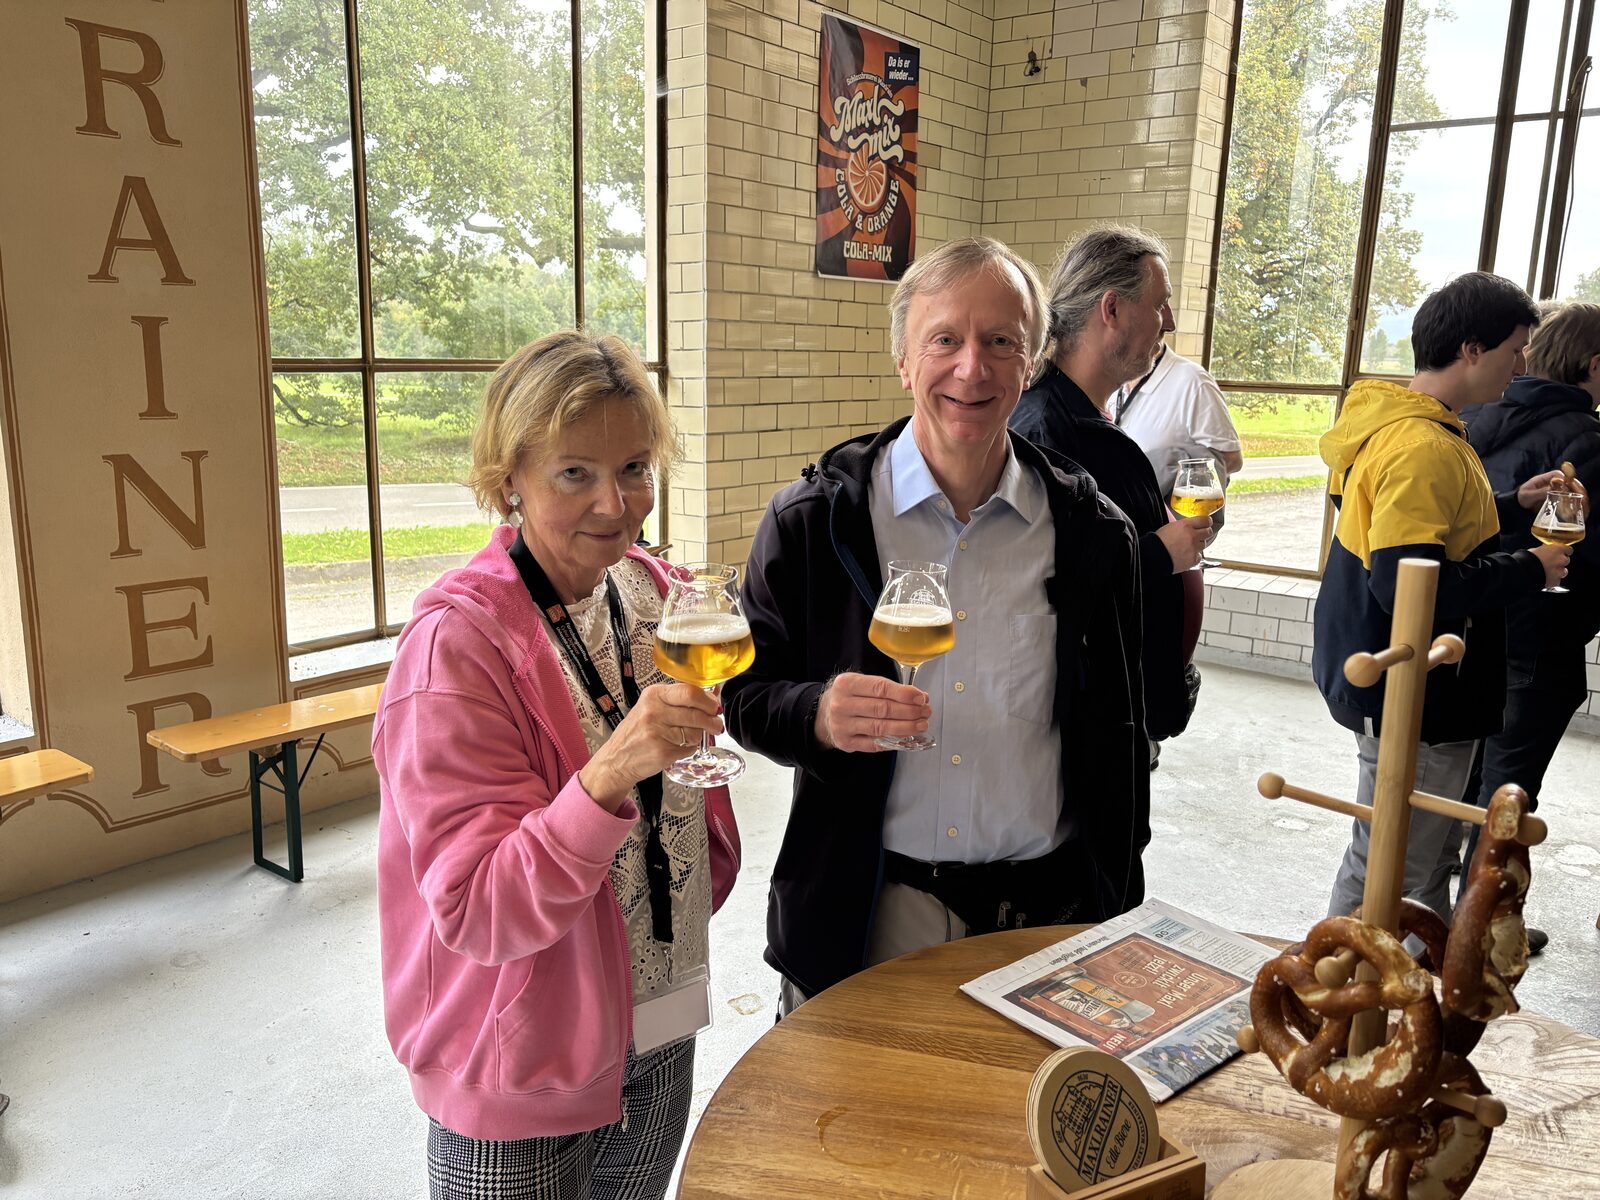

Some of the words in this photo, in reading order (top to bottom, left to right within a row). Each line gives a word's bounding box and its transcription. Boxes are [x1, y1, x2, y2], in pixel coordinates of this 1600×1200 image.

[888, 56, 897, 68] Da
[897, 56, 904, 67] is
[903, 59, 911, 69] er
[830, 84, 904, 142] Maxl
[835, 168, 854, 221] COLA
[855, 214, 863, 231] &
[867, 179, 899, 233] ORANGE
[843, 240, 892, 262] COLA-MIX
[64, 0, 232, 799] RAINER
[1142, 954, 1172, 975] jetzt!
[1177, 972, 1208, 993] Unser
[1156, 989, 1187, 1009] Maxl
[1103, 1033, 1127, 1051] NEU!
[1081, 1081, 1119, 1181] MAXLRAINER
[1105, 1144, 1121, 1170] Edle
[1113, 1118, 1132, 1148] Biere
